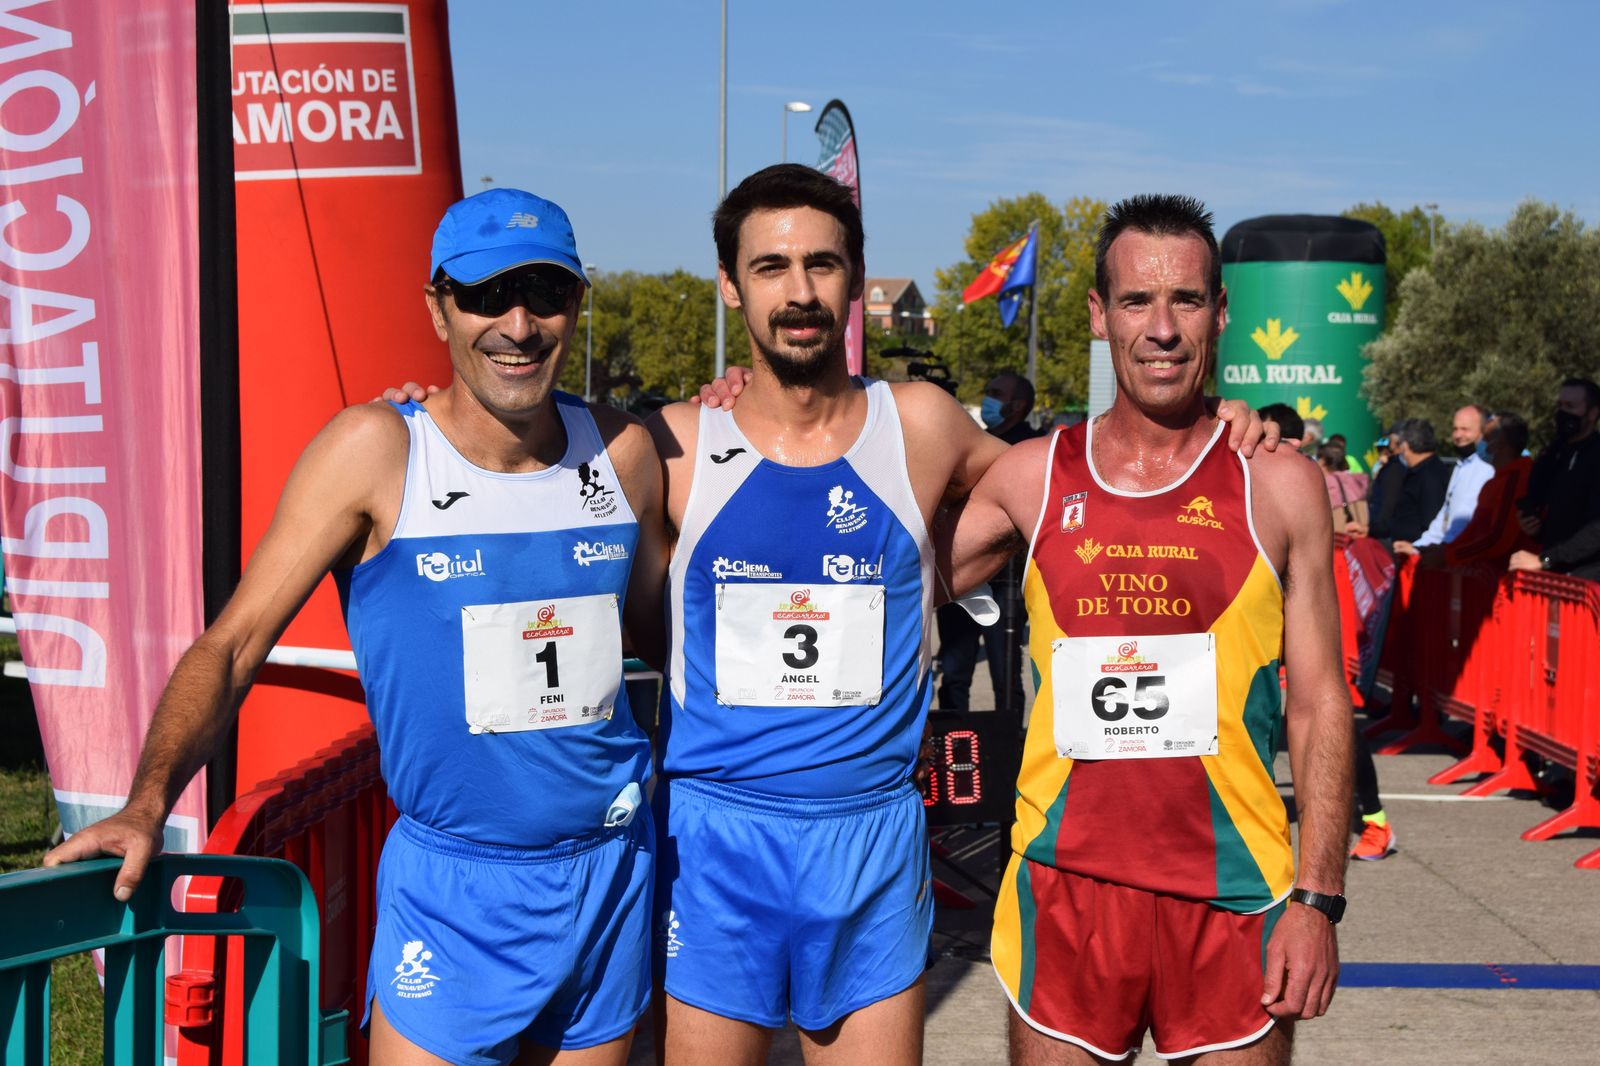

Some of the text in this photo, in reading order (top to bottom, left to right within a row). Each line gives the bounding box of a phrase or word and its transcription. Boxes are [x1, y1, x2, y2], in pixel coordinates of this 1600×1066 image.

[362, 69, 397, 92] DE
[1224, 364, 1342, 384] CAJA RURAL
[836, 514, 856, 523] CLUB
[1176, 514, 1225, 530] austral
[1106, 544, 1198, 560] CAJA RURAL
[1099, 573, 1168, 592] VINO
[1076, 596, 1191, 617] DE TORO
[782, 624, 819, 669] 3
[535, 641, 560, 689] 1
[781, 673, 820, 684] ÁNGEL
[540, 694, 564, 705] FENI
[1091, 675, 1170, 722] 65
[1104, 726, 1160, 736] ROBERTO
